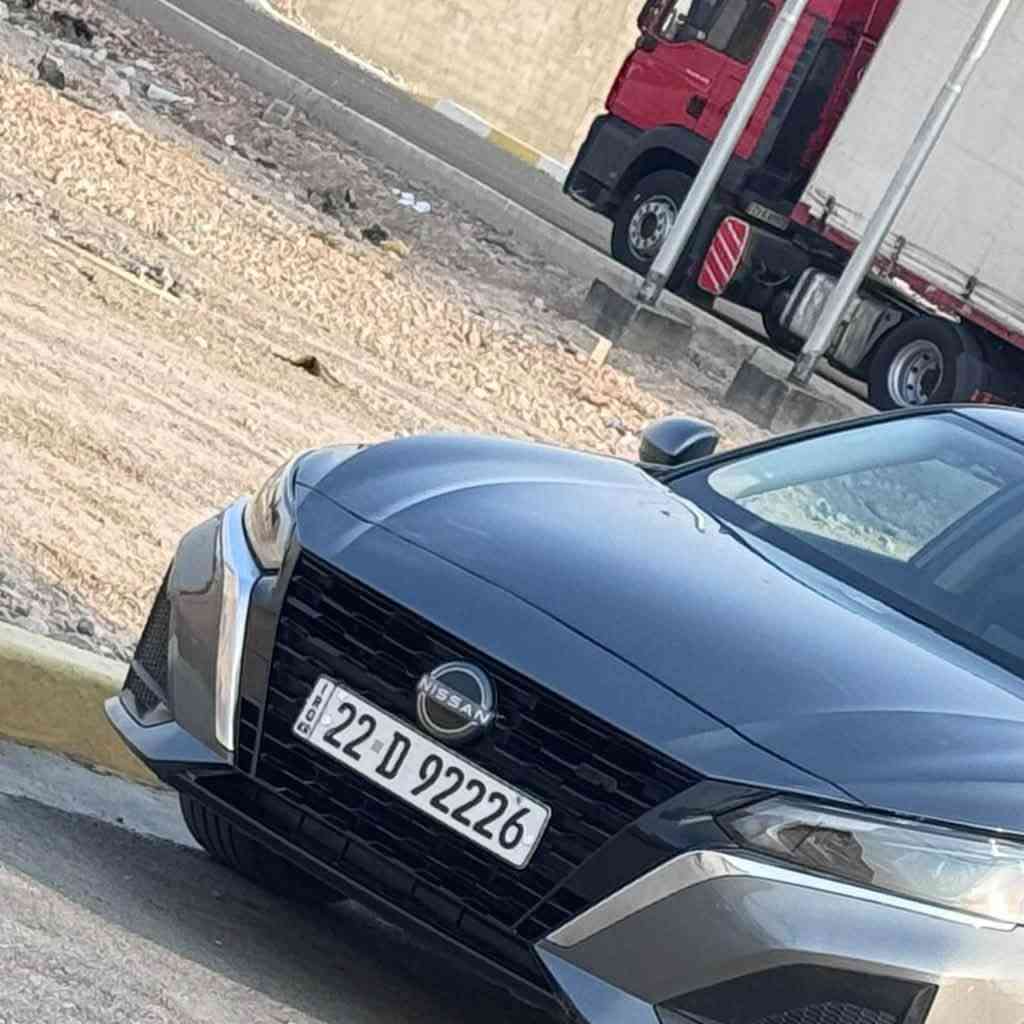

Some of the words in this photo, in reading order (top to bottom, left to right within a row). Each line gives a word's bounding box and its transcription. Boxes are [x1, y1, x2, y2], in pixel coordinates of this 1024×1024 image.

[417, 674, 491, 723] NISSAN
[323, 703, 377, 761] 22
[375, 731, 411, 780] D
[411, 754, 530, 850] 92226
